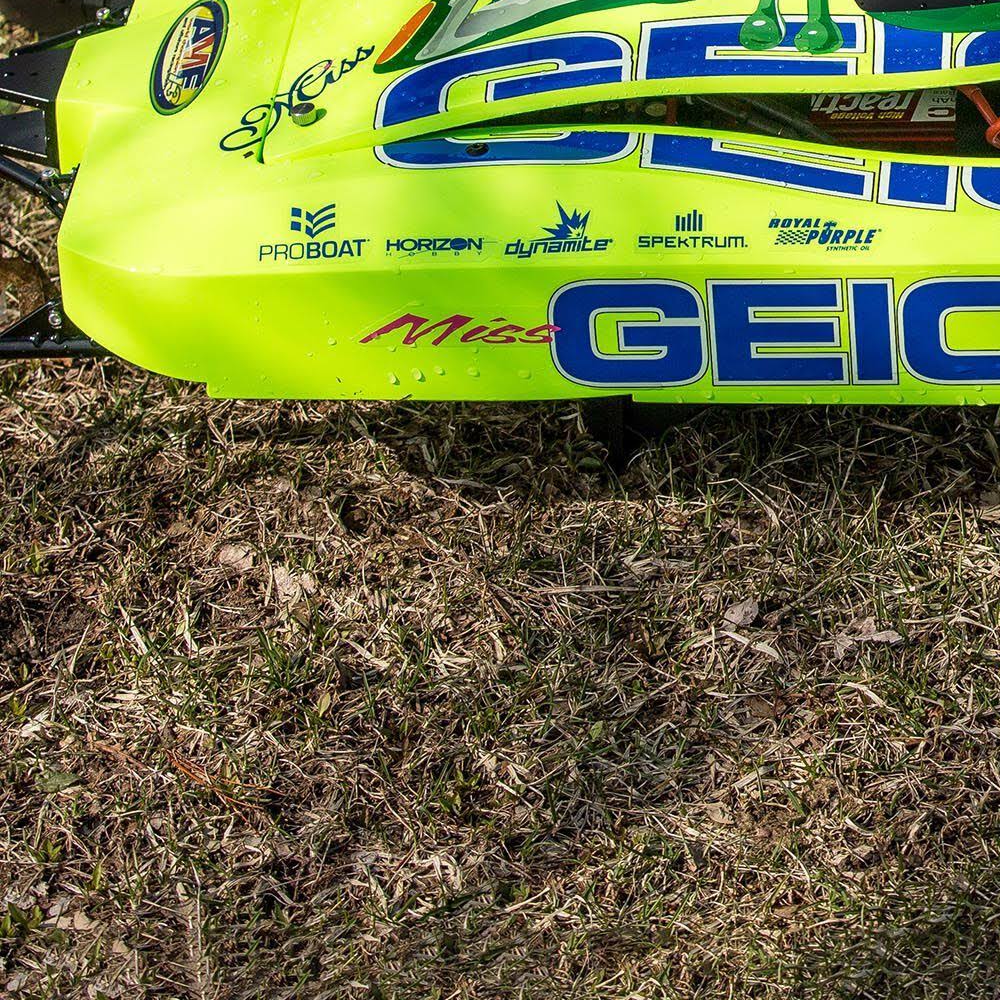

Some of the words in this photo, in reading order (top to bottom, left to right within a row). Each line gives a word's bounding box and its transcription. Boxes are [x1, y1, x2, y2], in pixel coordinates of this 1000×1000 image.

[830, 111, 874, 120] Voltage
[877, 111, 905, 119] High
[768, 218, 821, 228] ROYAL
[805, 225, 877, 245] PURPLE
[259, 238, 367, 262] PROBOAT
[386, 237, 483, 252] HORIZON
[504, 236, 609, 259] dynamite
[359, 313, 562, 347] Miss
